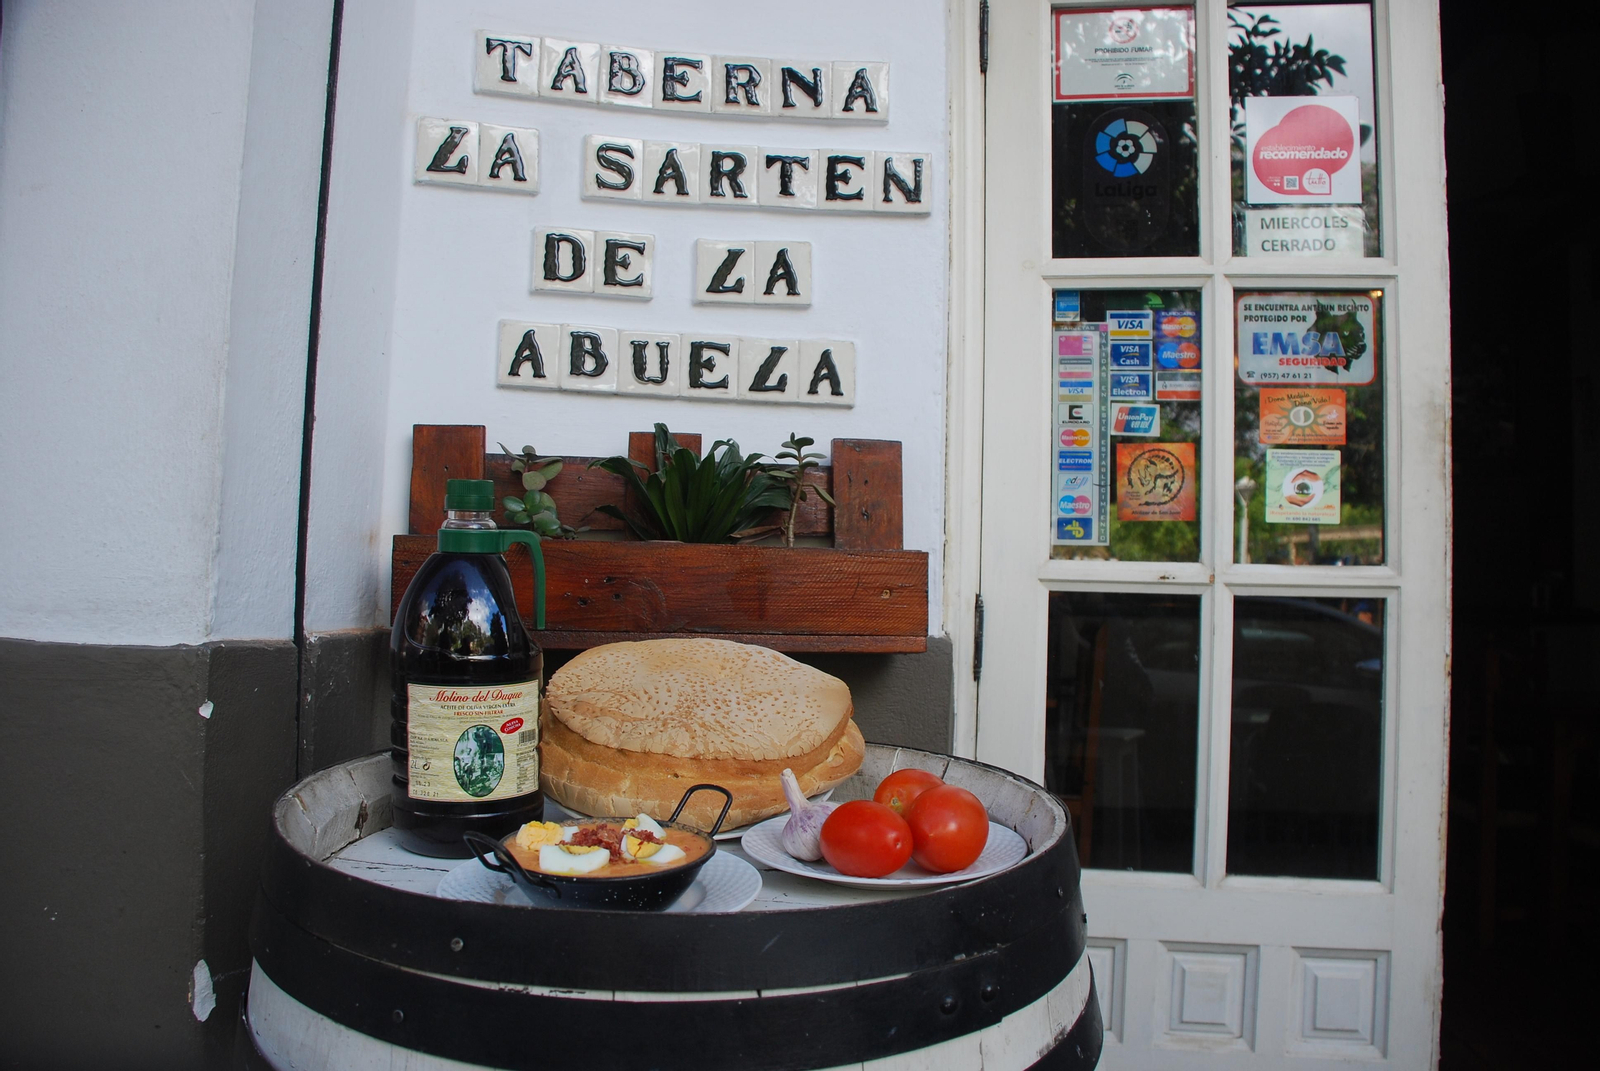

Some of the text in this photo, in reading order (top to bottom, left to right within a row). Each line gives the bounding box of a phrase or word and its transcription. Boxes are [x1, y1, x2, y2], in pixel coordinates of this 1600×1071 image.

[486, 38, 878, 113] TABERNA
[1260, 147, 1348, 160] recomendado
[426, 127, 924, 204] LA SARTEN
[1095, 181, 1157, 201] LaLiga
[1260, 216, 1349, 230] MIERCOLES
[1261, 238, 1336, 252] CERRADO
[543, 233, 801, 297] DE LA
[1254, 304, 1299, 312] ENCUENTRA
[1324, 304, 1335, 312] UN
[1337, 304, 1369, 312] RECINTO
[1117, 320, 1143, 330] VISA
[1243, 315, 1307, 323] PROTEGIDO POR
[1252, 332, 1346, 356] EMSA
[1162, 351, 1196, 359] Maestro
[508, 329, 844, 397] ABUELA
[1278, 357, 1347, 367] SEGURIDAD
[1112, 388, 1147, 396] Electron
[1117, 413, 1154, 424] UnionPay
[1059, 500, 1091, 510] Maestro
[429, 689, 523, 704] Molino del Duque
